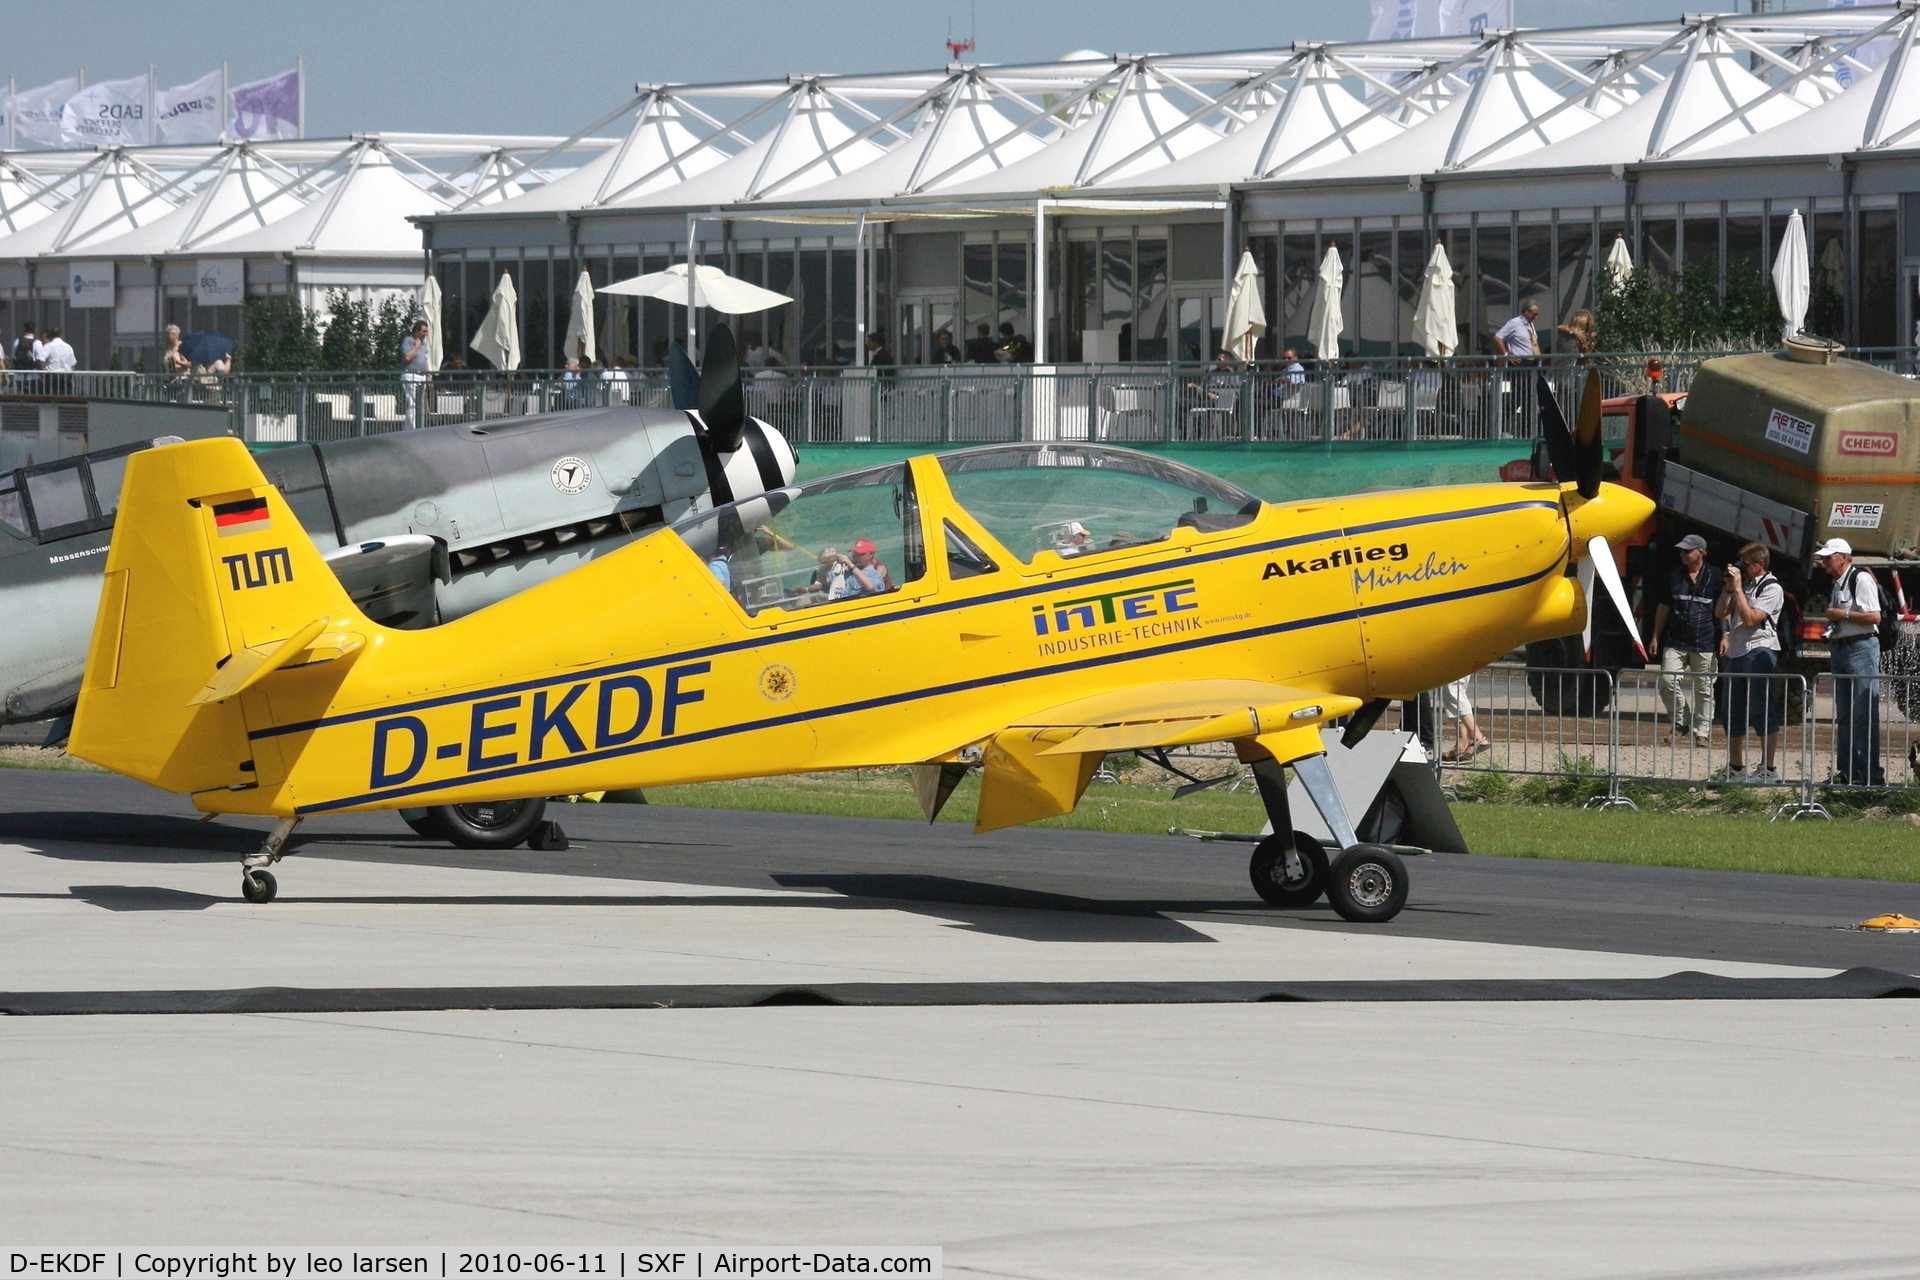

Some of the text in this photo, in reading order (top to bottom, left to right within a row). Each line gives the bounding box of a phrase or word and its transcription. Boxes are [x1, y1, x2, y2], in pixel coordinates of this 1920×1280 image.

[1844, 437, 1892, 450] CHEMO
[1831, 518, 1845, 527] (030)
[221, 546, 294, 591] TUM
[1261, 542, 1410, 580] Akaflieg
[1353, 551, 1470, 595] München
[1037, 615, 1203, 657] INDUSTRIE-TECHNIK
[369, 660, 712, 790] D-EKDF
